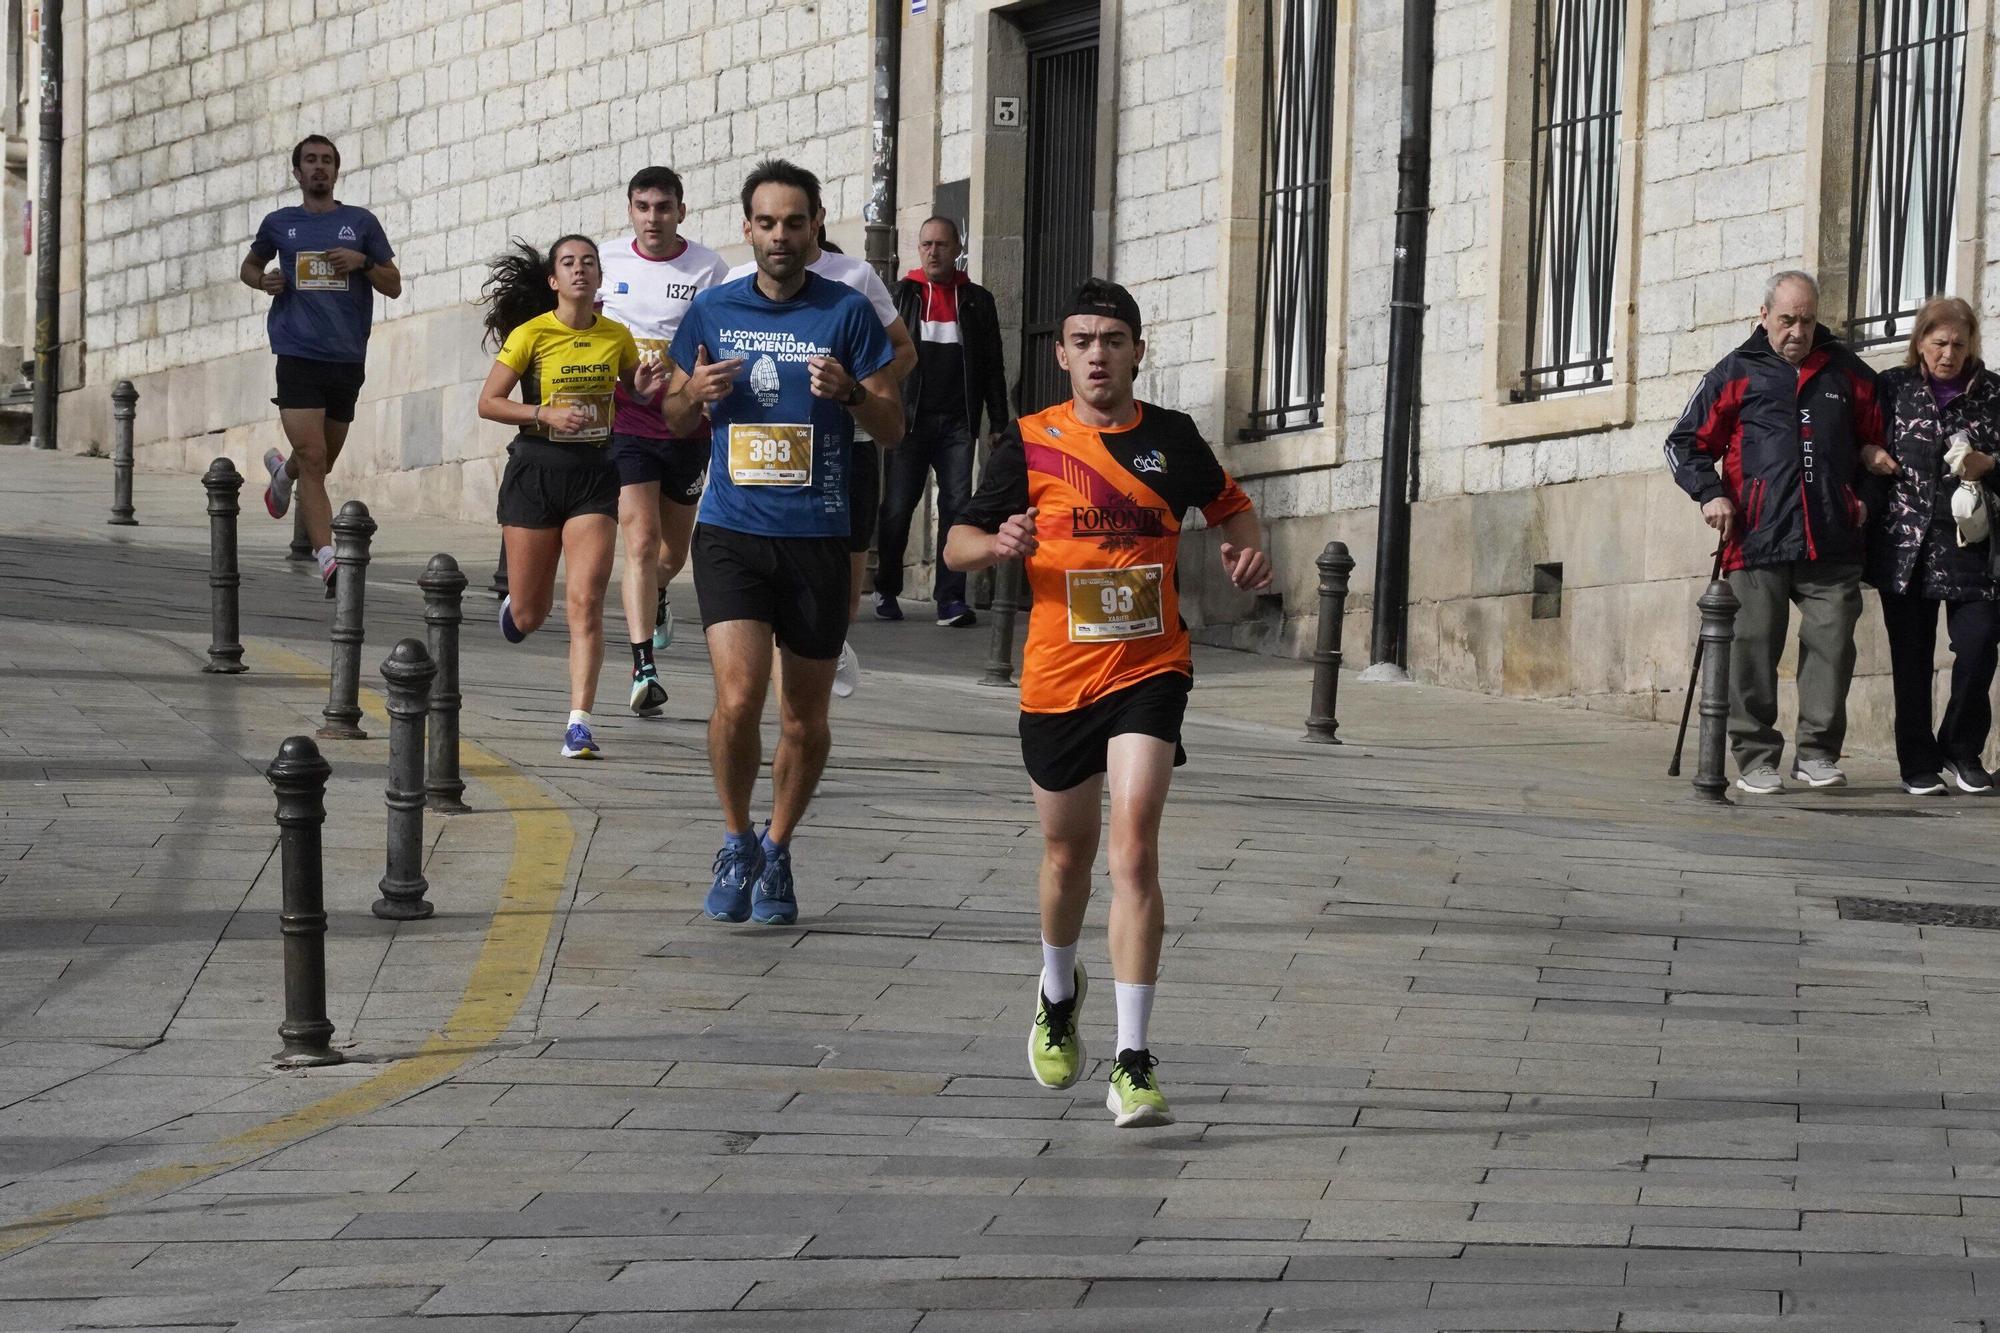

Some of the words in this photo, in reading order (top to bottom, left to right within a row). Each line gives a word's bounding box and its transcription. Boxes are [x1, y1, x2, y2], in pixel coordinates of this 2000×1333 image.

[999, 101, 1014, 121] 3
[666, 283, 698, 302] 1327
[719, 328, 732, 338] LA
[733, 330, 795, 341] CONQUISTA
[734, 338, 816, 353] ALMENDRA
[560, 364, 611, 375] GAIKAR
[749, 439, 791, 463] 393
[1145, 571, 1158, 581] 10K
[1100, 586, 1134, 614] 93
